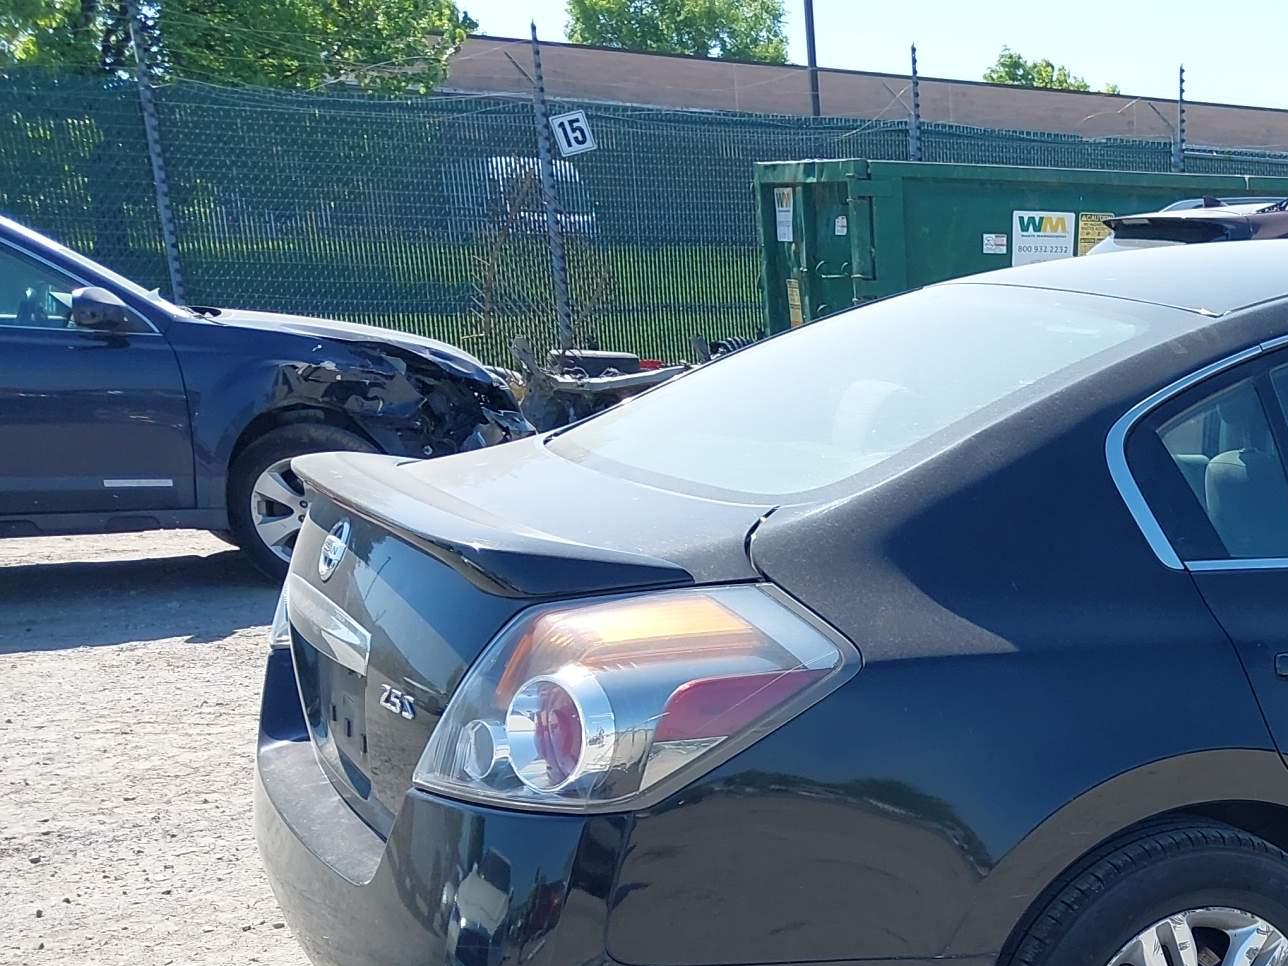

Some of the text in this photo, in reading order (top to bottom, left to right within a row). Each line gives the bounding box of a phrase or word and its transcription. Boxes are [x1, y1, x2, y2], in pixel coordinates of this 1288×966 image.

[557, 117, 588, 148] 15
[1018, 215, 1067, 233] WM
[1018, 245, 1033, 253] 800
